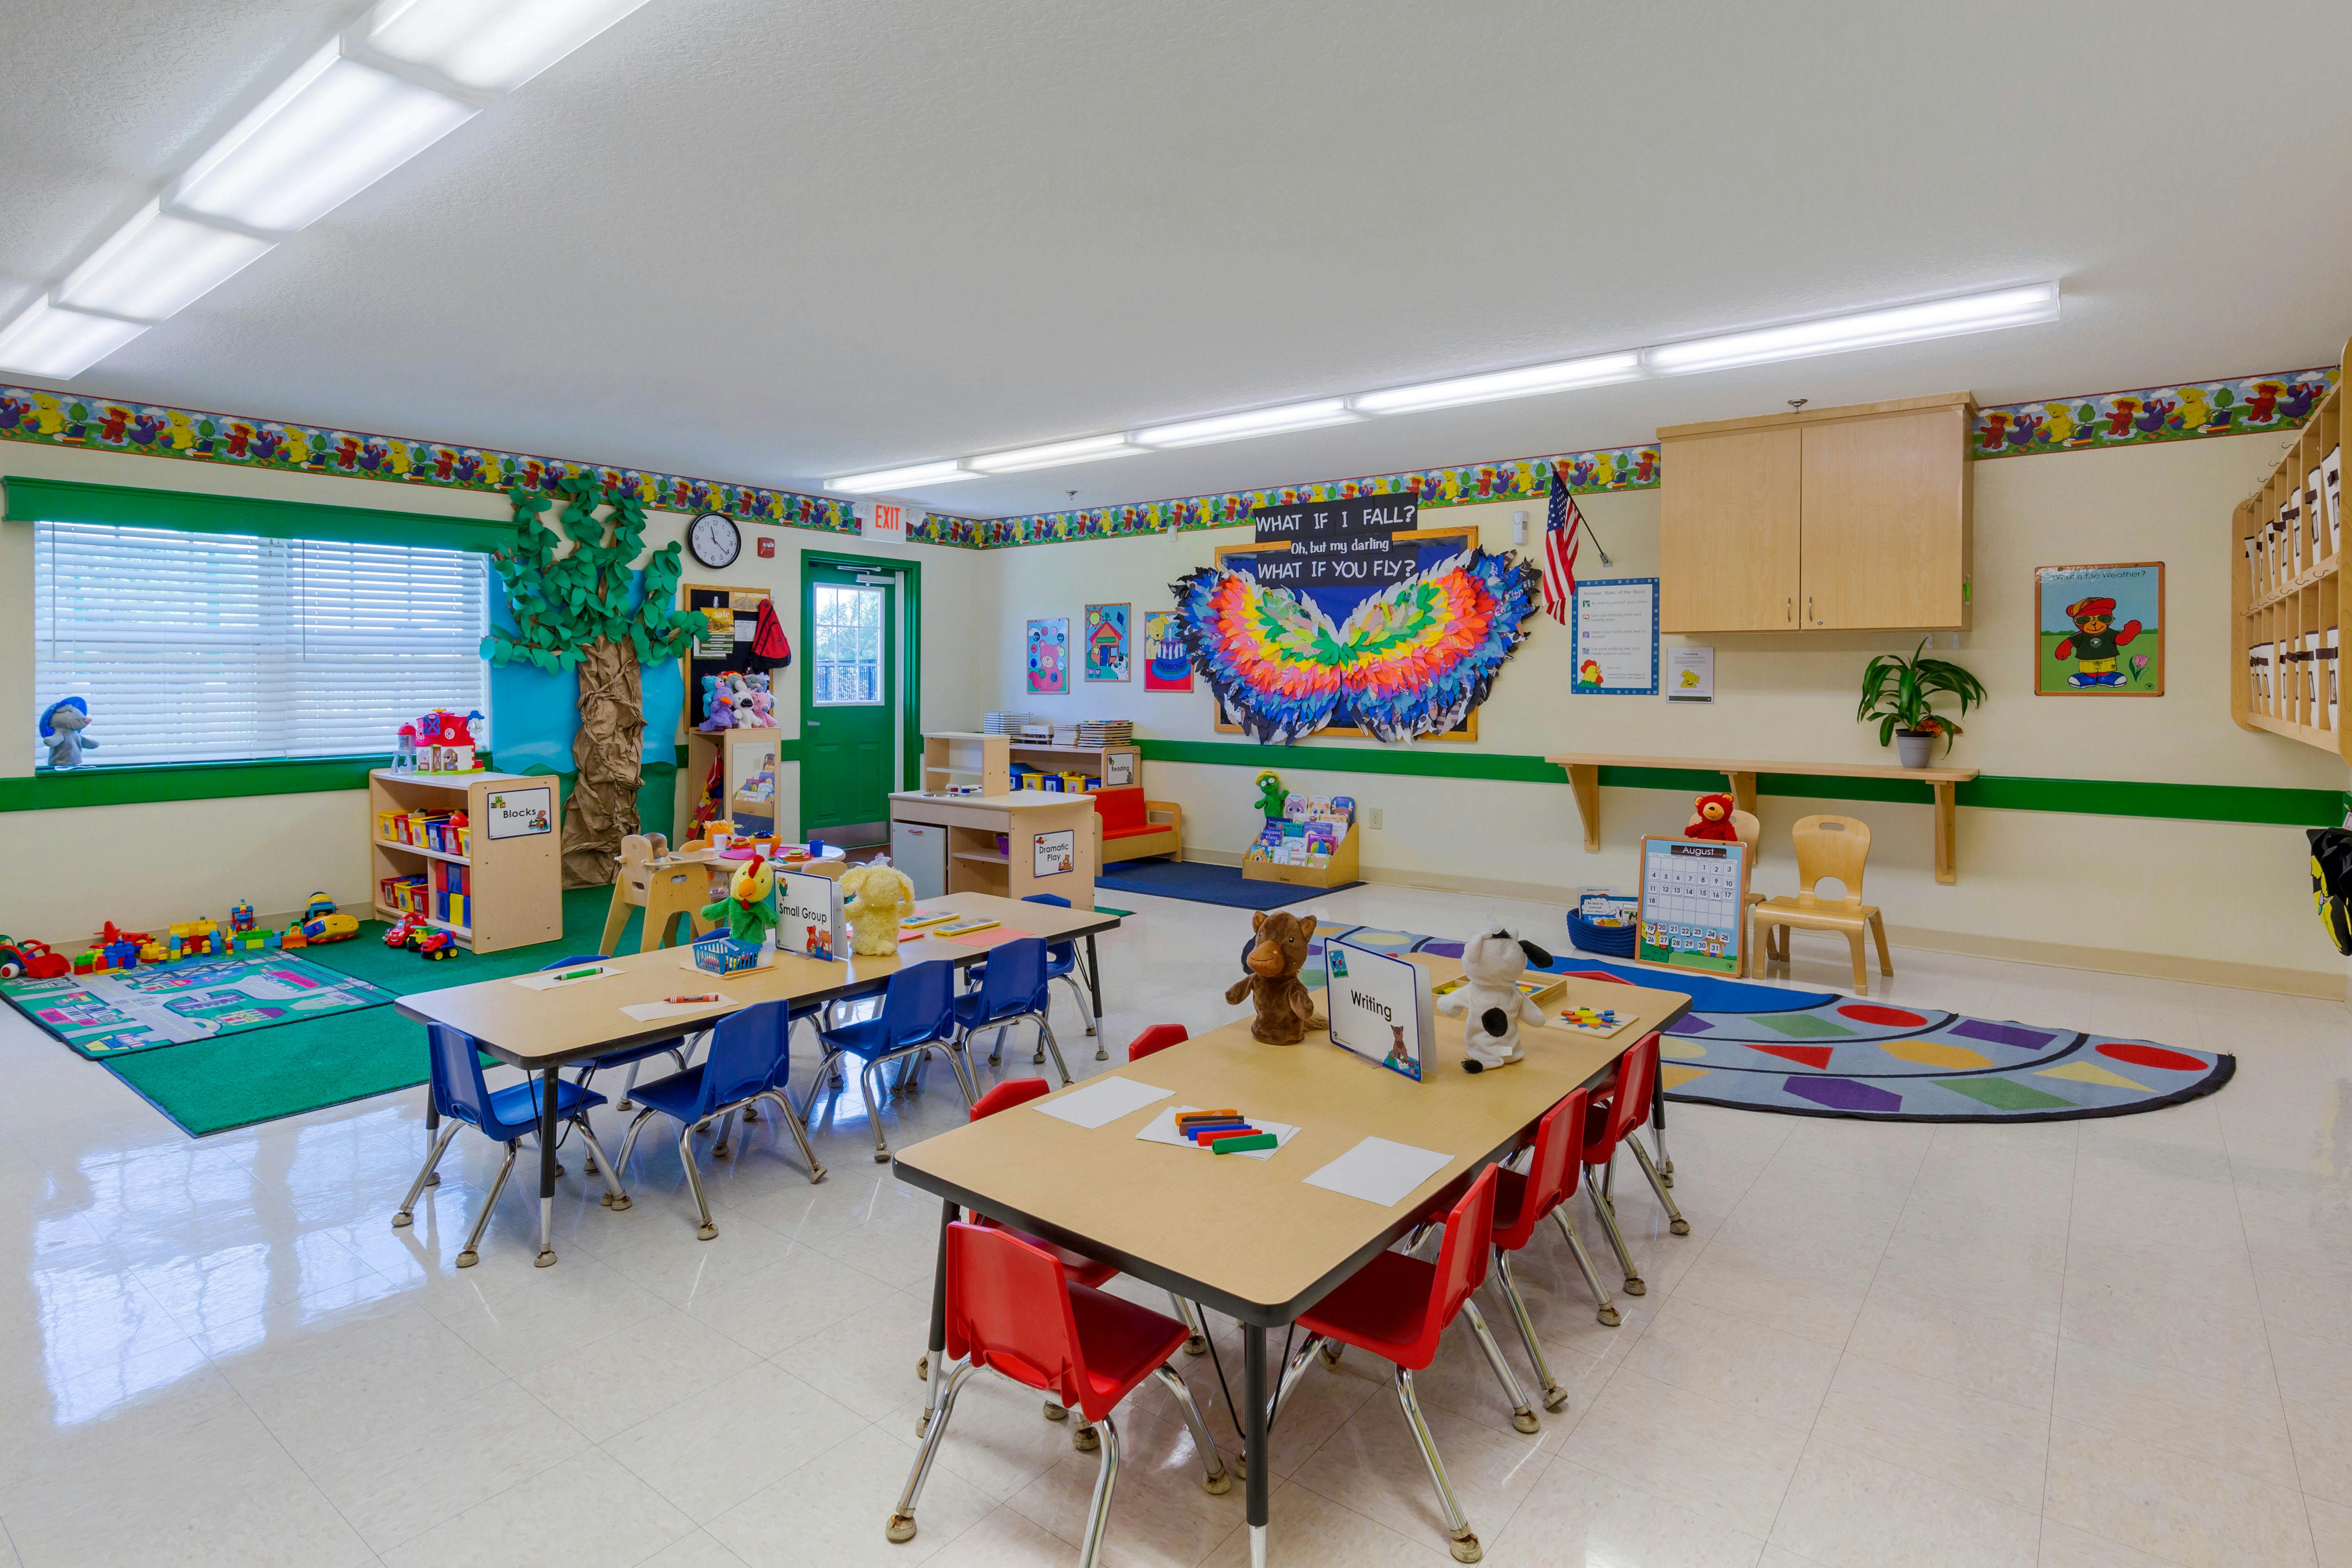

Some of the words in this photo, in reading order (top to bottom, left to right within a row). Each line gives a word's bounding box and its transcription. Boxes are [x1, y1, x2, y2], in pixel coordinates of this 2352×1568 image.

[875, 505, 901, 530] EXIT
[1256, 514, 1302, 532] WHAT
[1314, 512, 1328, 529] IF
[1342, 511, 1348, 528] I
[1363, 506, 1415, 525] FALL?
[1291, 542, 1307, 555] Oh,
[1310, 541, 1327, 553] but
[1330, 541, 1347, 554] my
[1351, 537, 1389, 552] darling
[1258, 562, 1302, 579] WHAT
[1312, 561, 1326, 577] IF
[1332, 561, 1367, 578] YOU
[1374, 560, 1416, 577] FLY?
[1158, 659, 1184, 670] PRIMROSE
[503, 808, 536, 818] Blocks
[1040, 843, 1068, 853] Dramatic
[1682, 846, 1714, 856] August
[780, 903, 799, 917] Small
[802, 907, 826, 924] Group
[1351, 989, 1392, 1022] Writing
